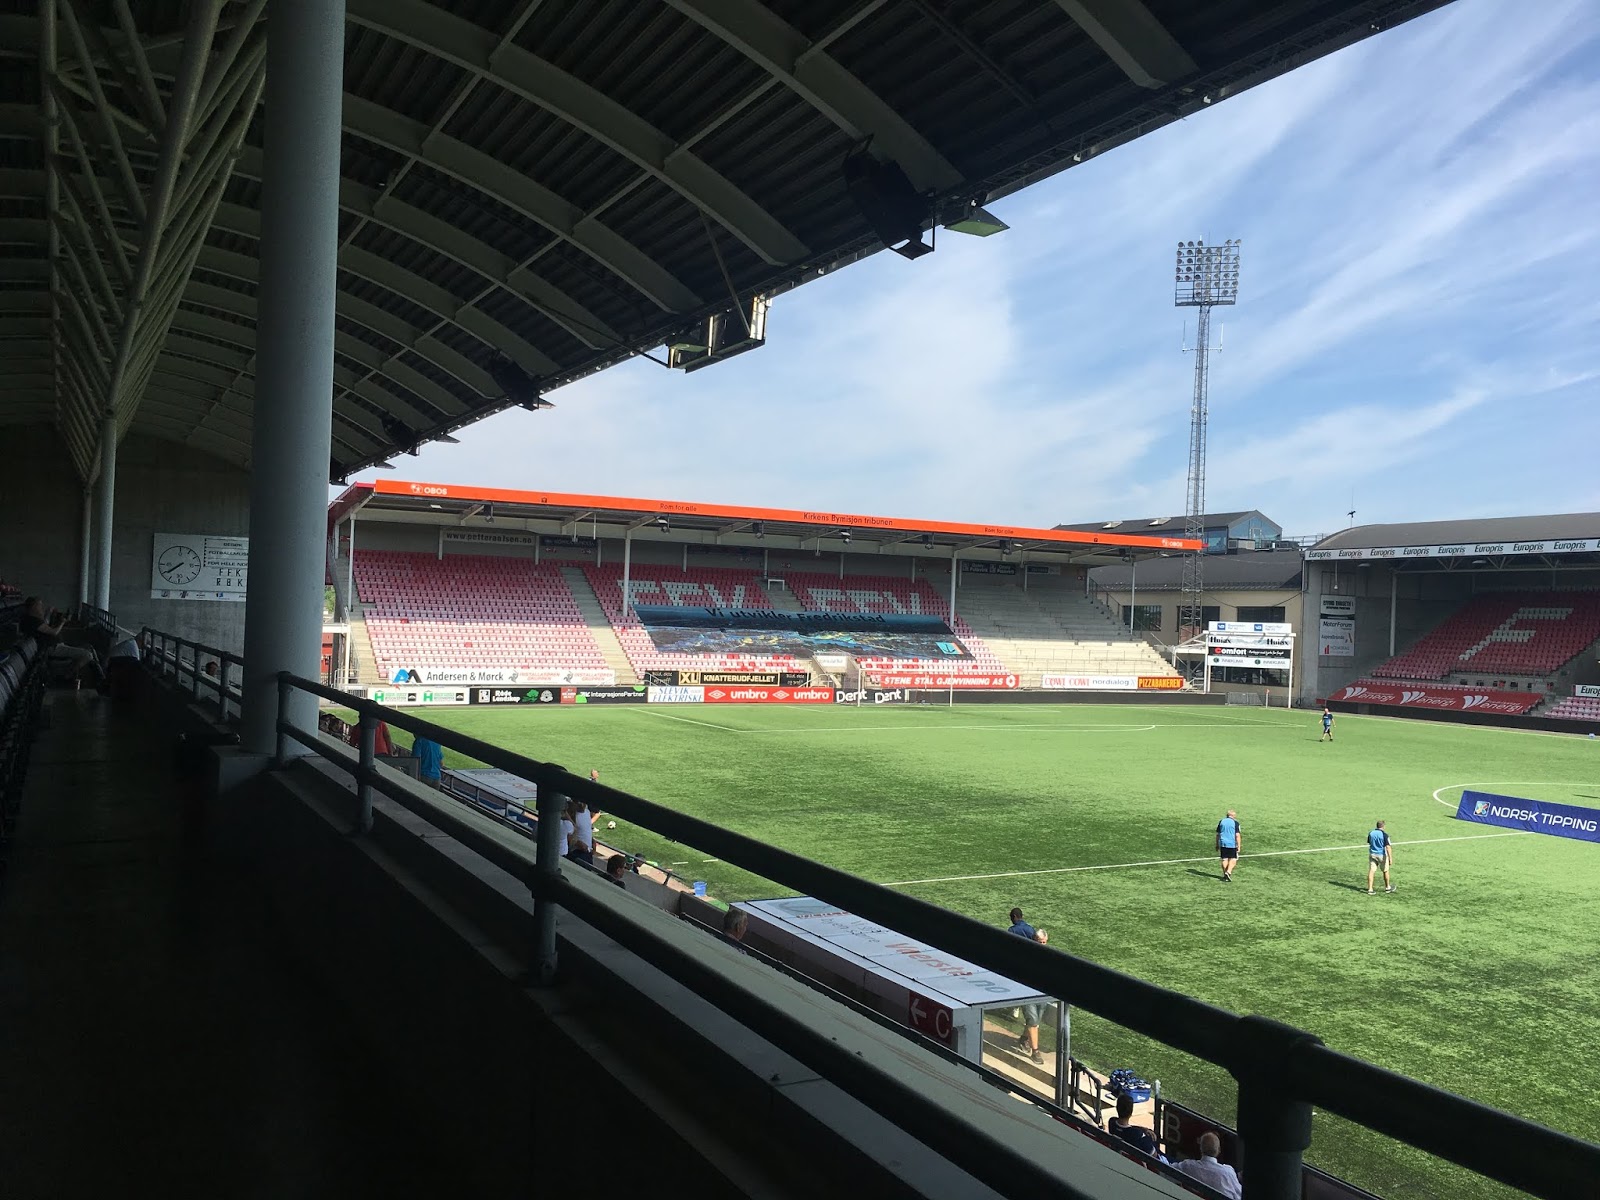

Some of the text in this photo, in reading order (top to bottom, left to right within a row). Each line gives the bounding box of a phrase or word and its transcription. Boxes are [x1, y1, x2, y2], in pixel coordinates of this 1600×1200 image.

[424, 486, 448, 495] OBOS
[803, 512, 893, 526] Kirkens Bymisjon tribunen
[1308, 550, 1332, 559] Europris
[1338, 549, 1363, 558] Europris
[1370, 548, 1395, 557] Europris
[1403, 547, 1430, 557] Europris
[1437, 545, 1465, 556] Europris
[1474, 544, 1504, 554] Europris
[1512, 542, 1544, 553] Europris
[1553, 541, 1587, 551] Europris
[704, 608, 886, 624] Vi utvikler Fredrikstad
[1214, 647, 1247, 656] Comfort
[426, 672, 504, 681] Andersen & Mørck
[680, 672, 699, 684] XL
[703, 674, 775, 683] KNATTERUDFJELLET
[884, 676, 911, 685] STENE
[936, 677, 990, 686] GJENVINNING
[1045, 677, 1090, 687] COWI COWI
[1092, 678, 1130, 687] nordialog
[1138, 678, 1182, 688] PIZZABAKEREN
[658, 687, 690, 695] SLEVIK
[730, 689, 830, 700] umbro umbro
[836, 688, 867, 703] Dent
[874, 688, 902, 704] Dent
[1358, 693, 1395, 702] energi
[1417, 696, 1456, 706] energi
[1480, 700, 1523, 712] energi
[1490, 806, 1598, 832] NORSK TIPPING
[935, 1009, 950, 1039] C
[1165, 1110, 1181, 1144] B
